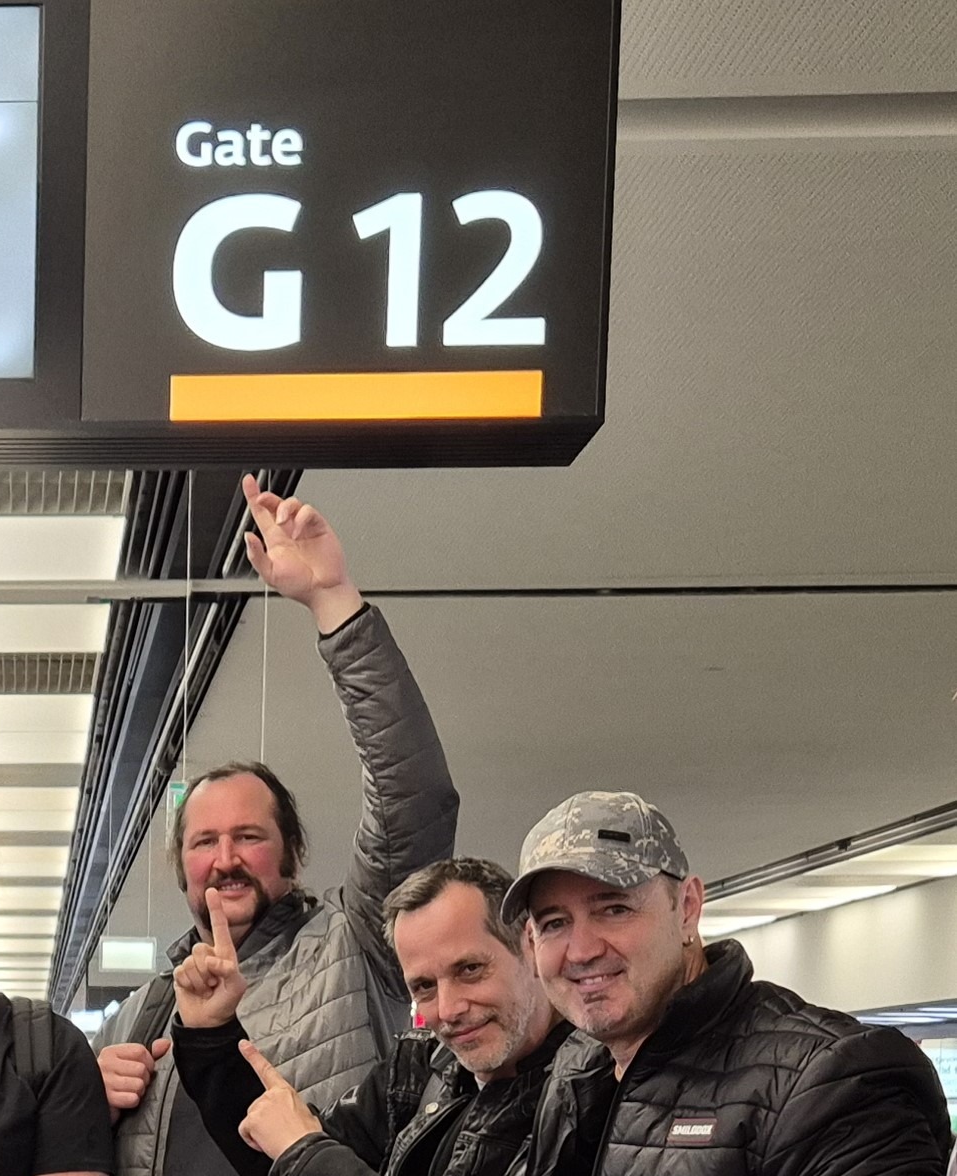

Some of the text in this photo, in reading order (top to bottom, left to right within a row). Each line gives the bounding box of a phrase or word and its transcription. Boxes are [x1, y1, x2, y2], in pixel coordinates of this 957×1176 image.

[175, 120, 304, 167] Gate
[172, 189, 547, 352] G 12
